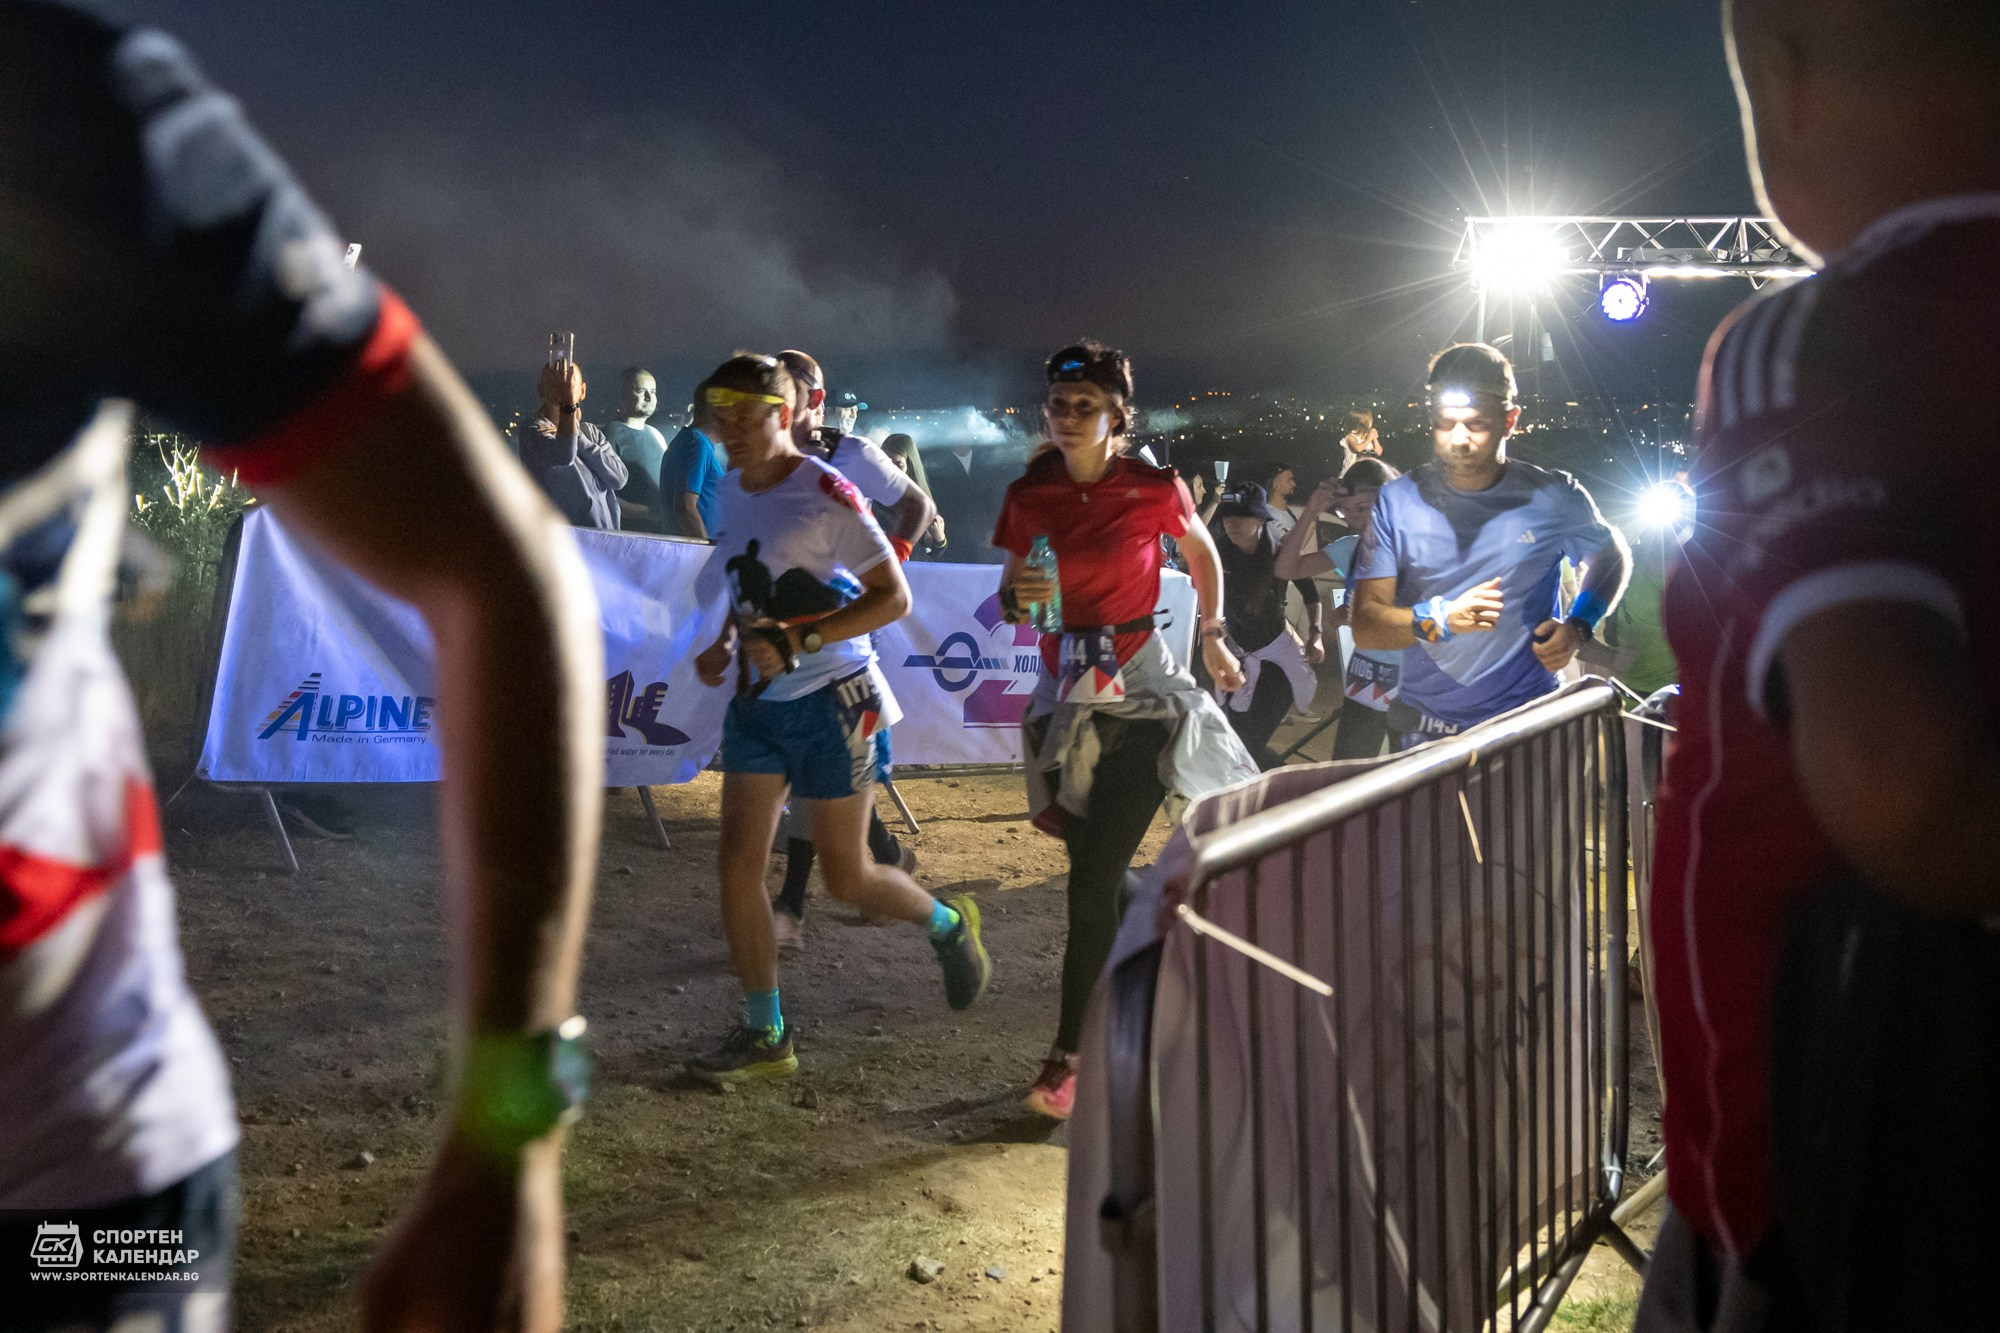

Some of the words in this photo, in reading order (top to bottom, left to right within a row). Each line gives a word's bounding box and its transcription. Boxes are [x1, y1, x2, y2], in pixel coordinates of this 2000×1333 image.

[257, 690, 436, 741] ALPINE
[311, 734, 353, 744] Made
[357, 734, 369, 744] in
[373, 735, 427, 745] Germany
[620, 748, 638, 756] water
[639, 747, 648, 756] for
[649, 748, 664, 757] every
[665, 748, 675, 758] day
